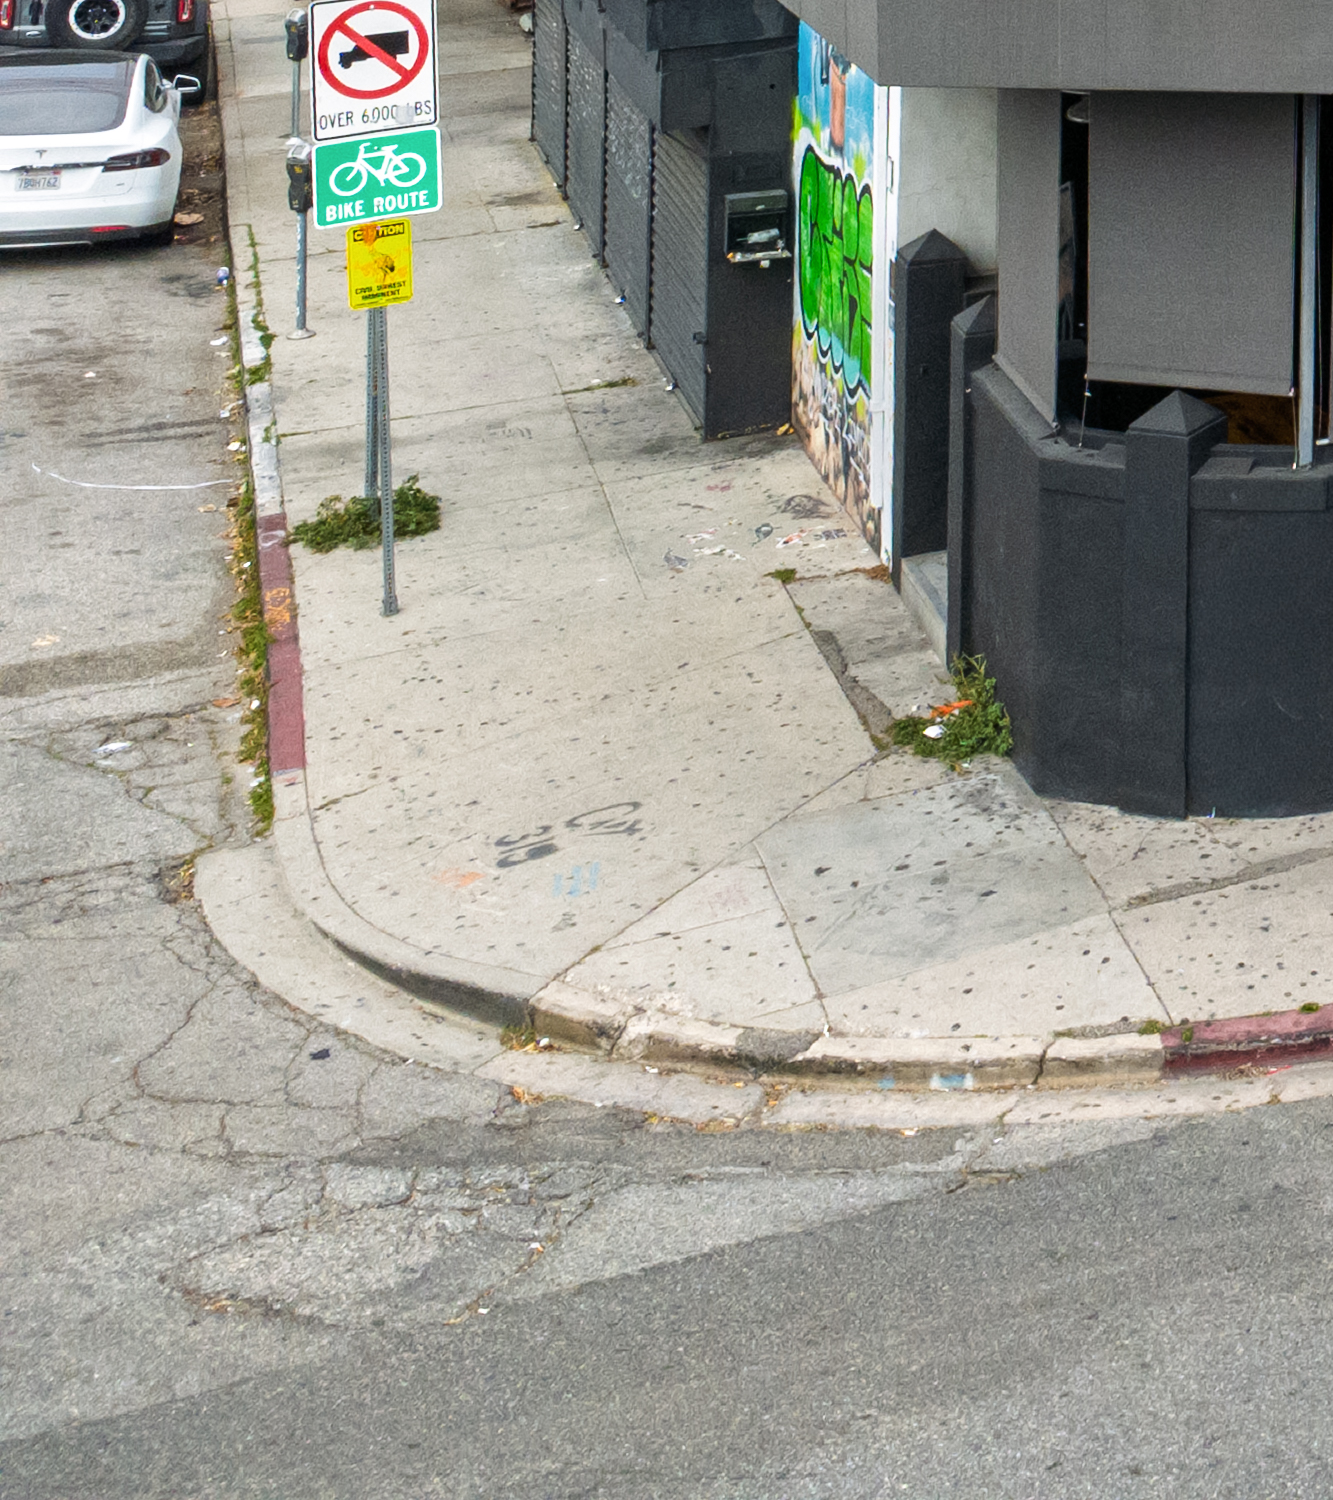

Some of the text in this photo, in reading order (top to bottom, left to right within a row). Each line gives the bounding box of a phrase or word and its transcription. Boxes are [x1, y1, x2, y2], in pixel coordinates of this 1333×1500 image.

[319, 111, 354, 130] OVER
[326, 190, 429, 222] BIKE ROUTE
[354, 224, 404, 241] CTION
